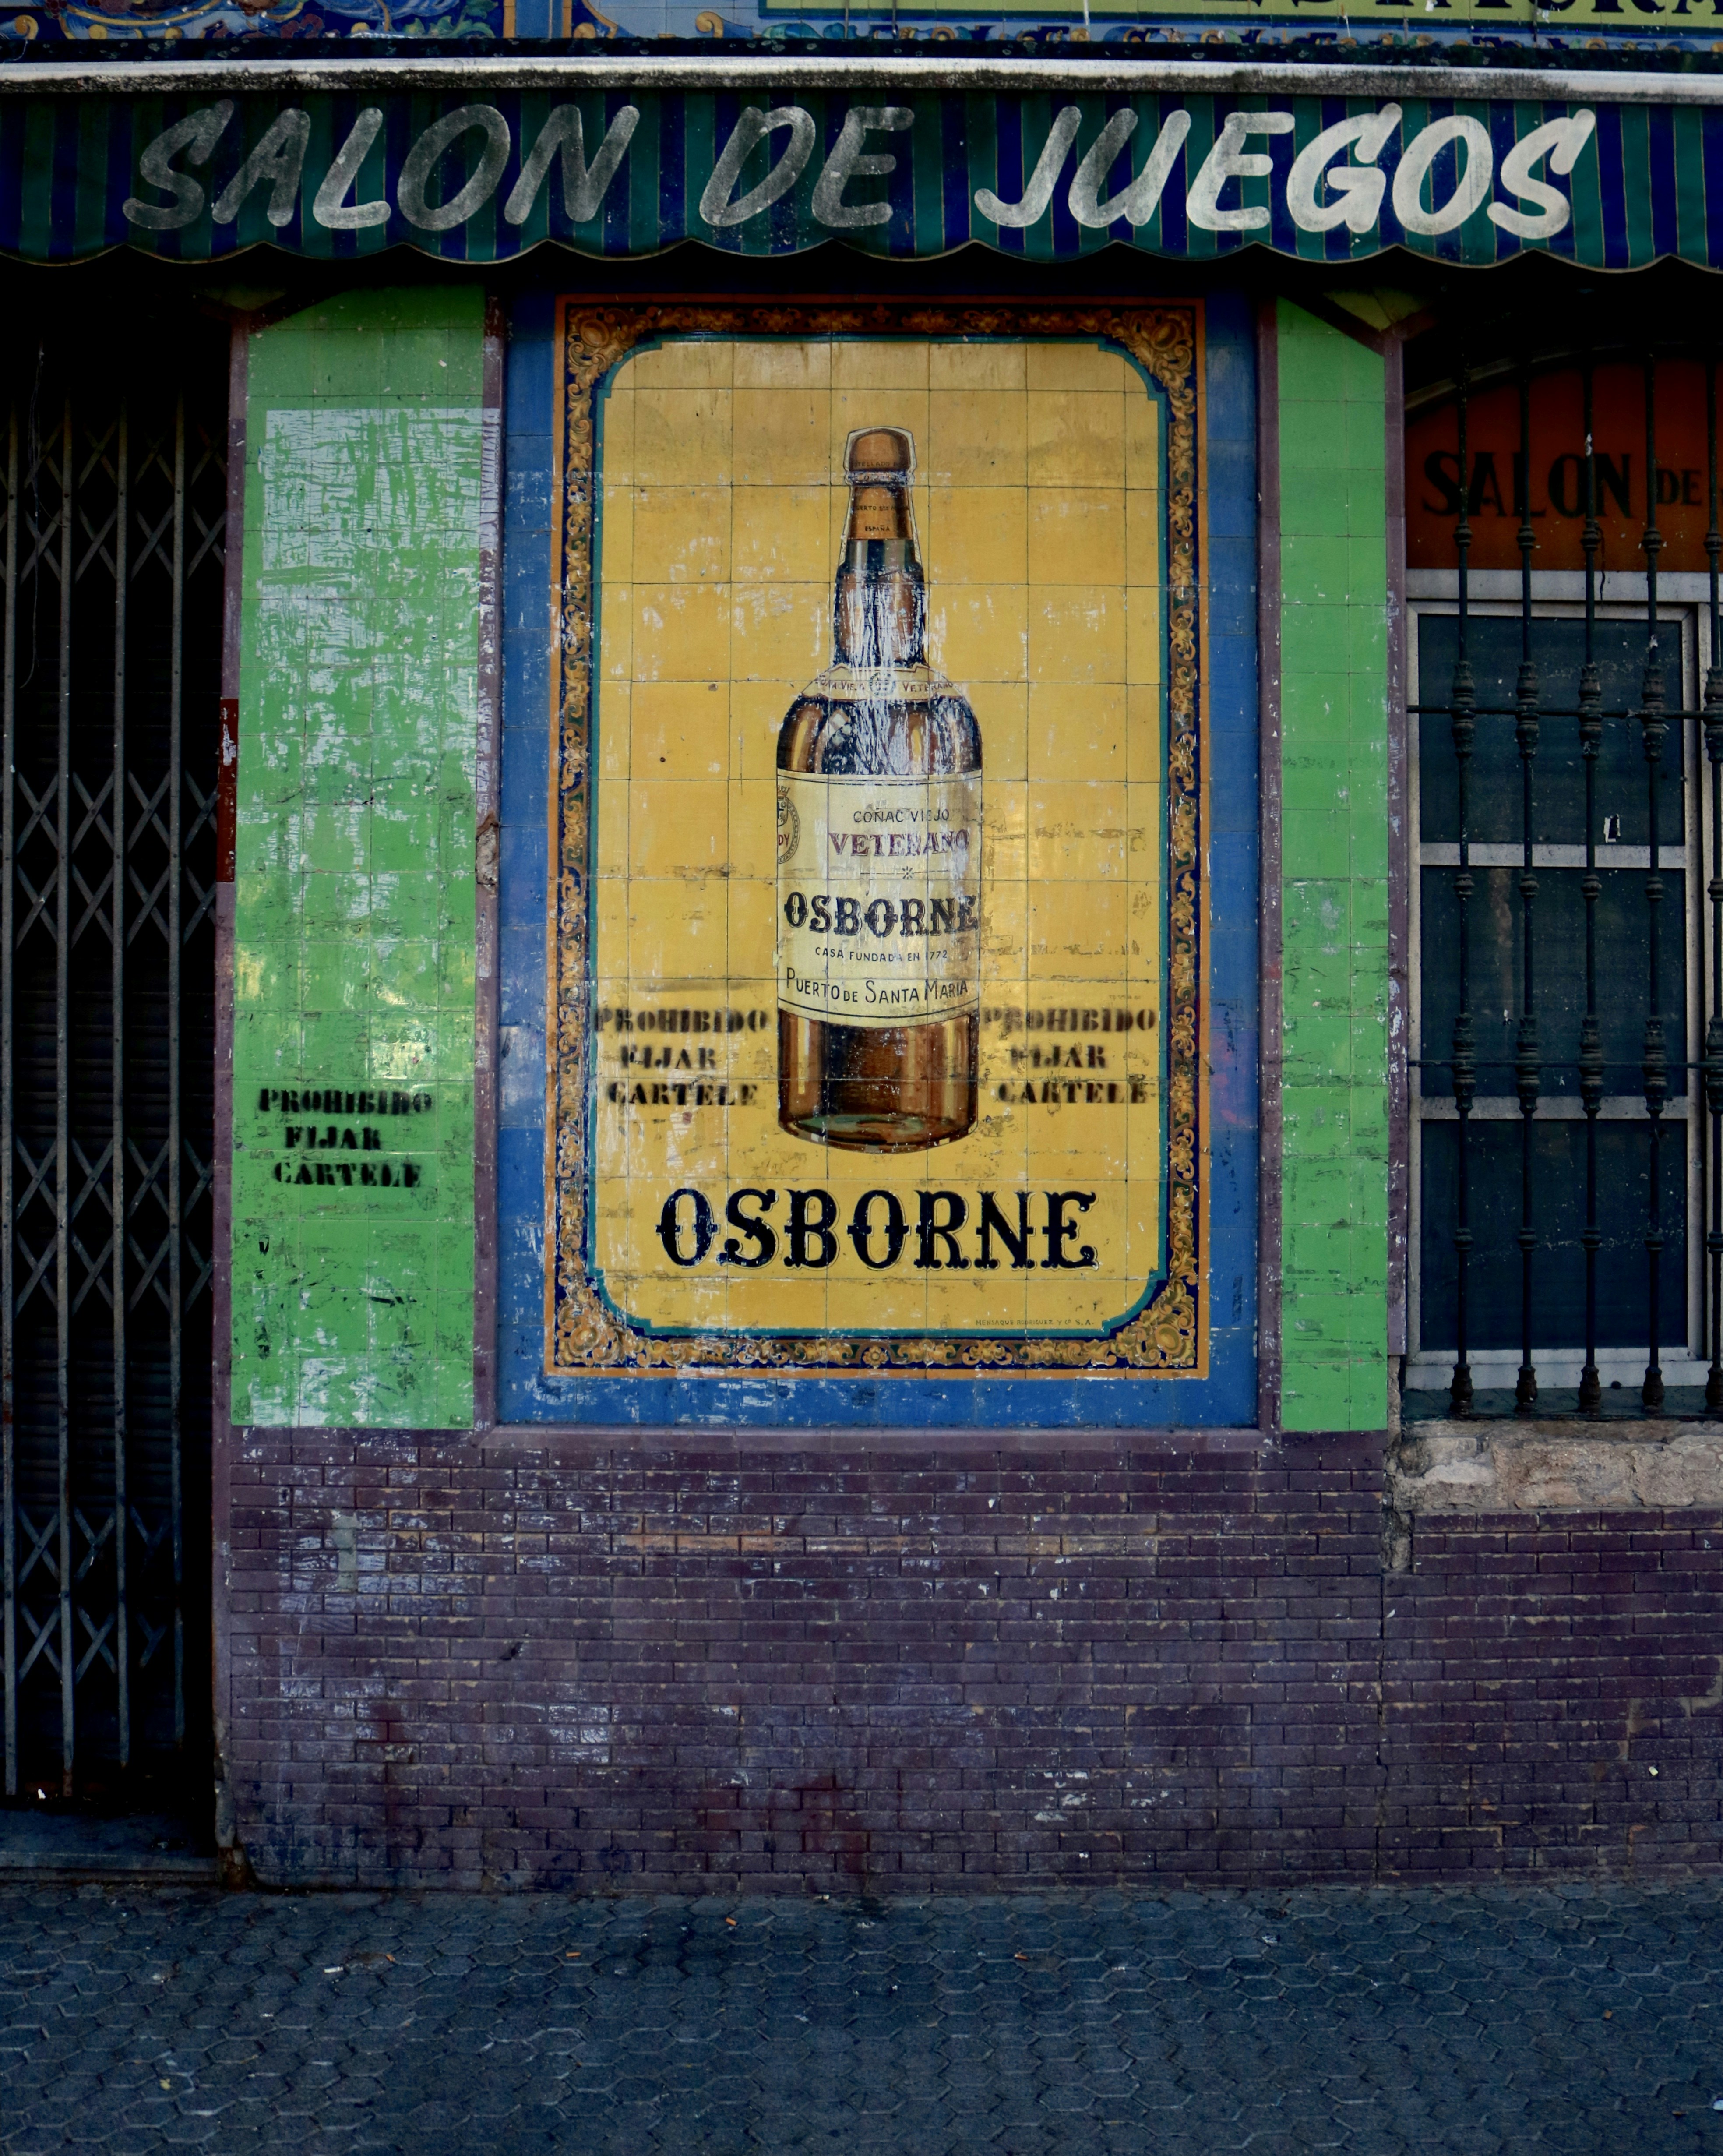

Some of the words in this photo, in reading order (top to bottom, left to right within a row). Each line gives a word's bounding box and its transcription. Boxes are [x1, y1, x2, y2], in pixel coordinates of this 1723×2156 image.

[122, 100, 640, 229] SALON
[699, 104, 915, 226] DE
[973, 102, 1596, 239] JUEGOS
[1422, 449, 1634, 519] SALON
[1656, 468, 1703, 506] DE
[910, 809, 949, 822] VIEJO
[828, 829, 970, 857] VETERANO
[784, 891, 979, 938] OSBORNE
[815, 946, 844, 959] CASA
[849, 951, 902, 962] FUNDADA
[908, 952, 920, 962] EN
[926, 949, 948, 960] 1772
[786, 967, 840, 1001] PUERTO
[843, 990, 858, 1002] DE
[865, 980, 920, 1004] SANTA
[594, 1008, 768, 1033] PROHIBIDO
[982, 1008, 1156, 1032] PROHIBIDO
[259, 1088, 433, 1115] PROHIBIDO
[285, 1126, 381, 1150] FIJAR
[655, 1188, 1099, 1271] OSBORNE
